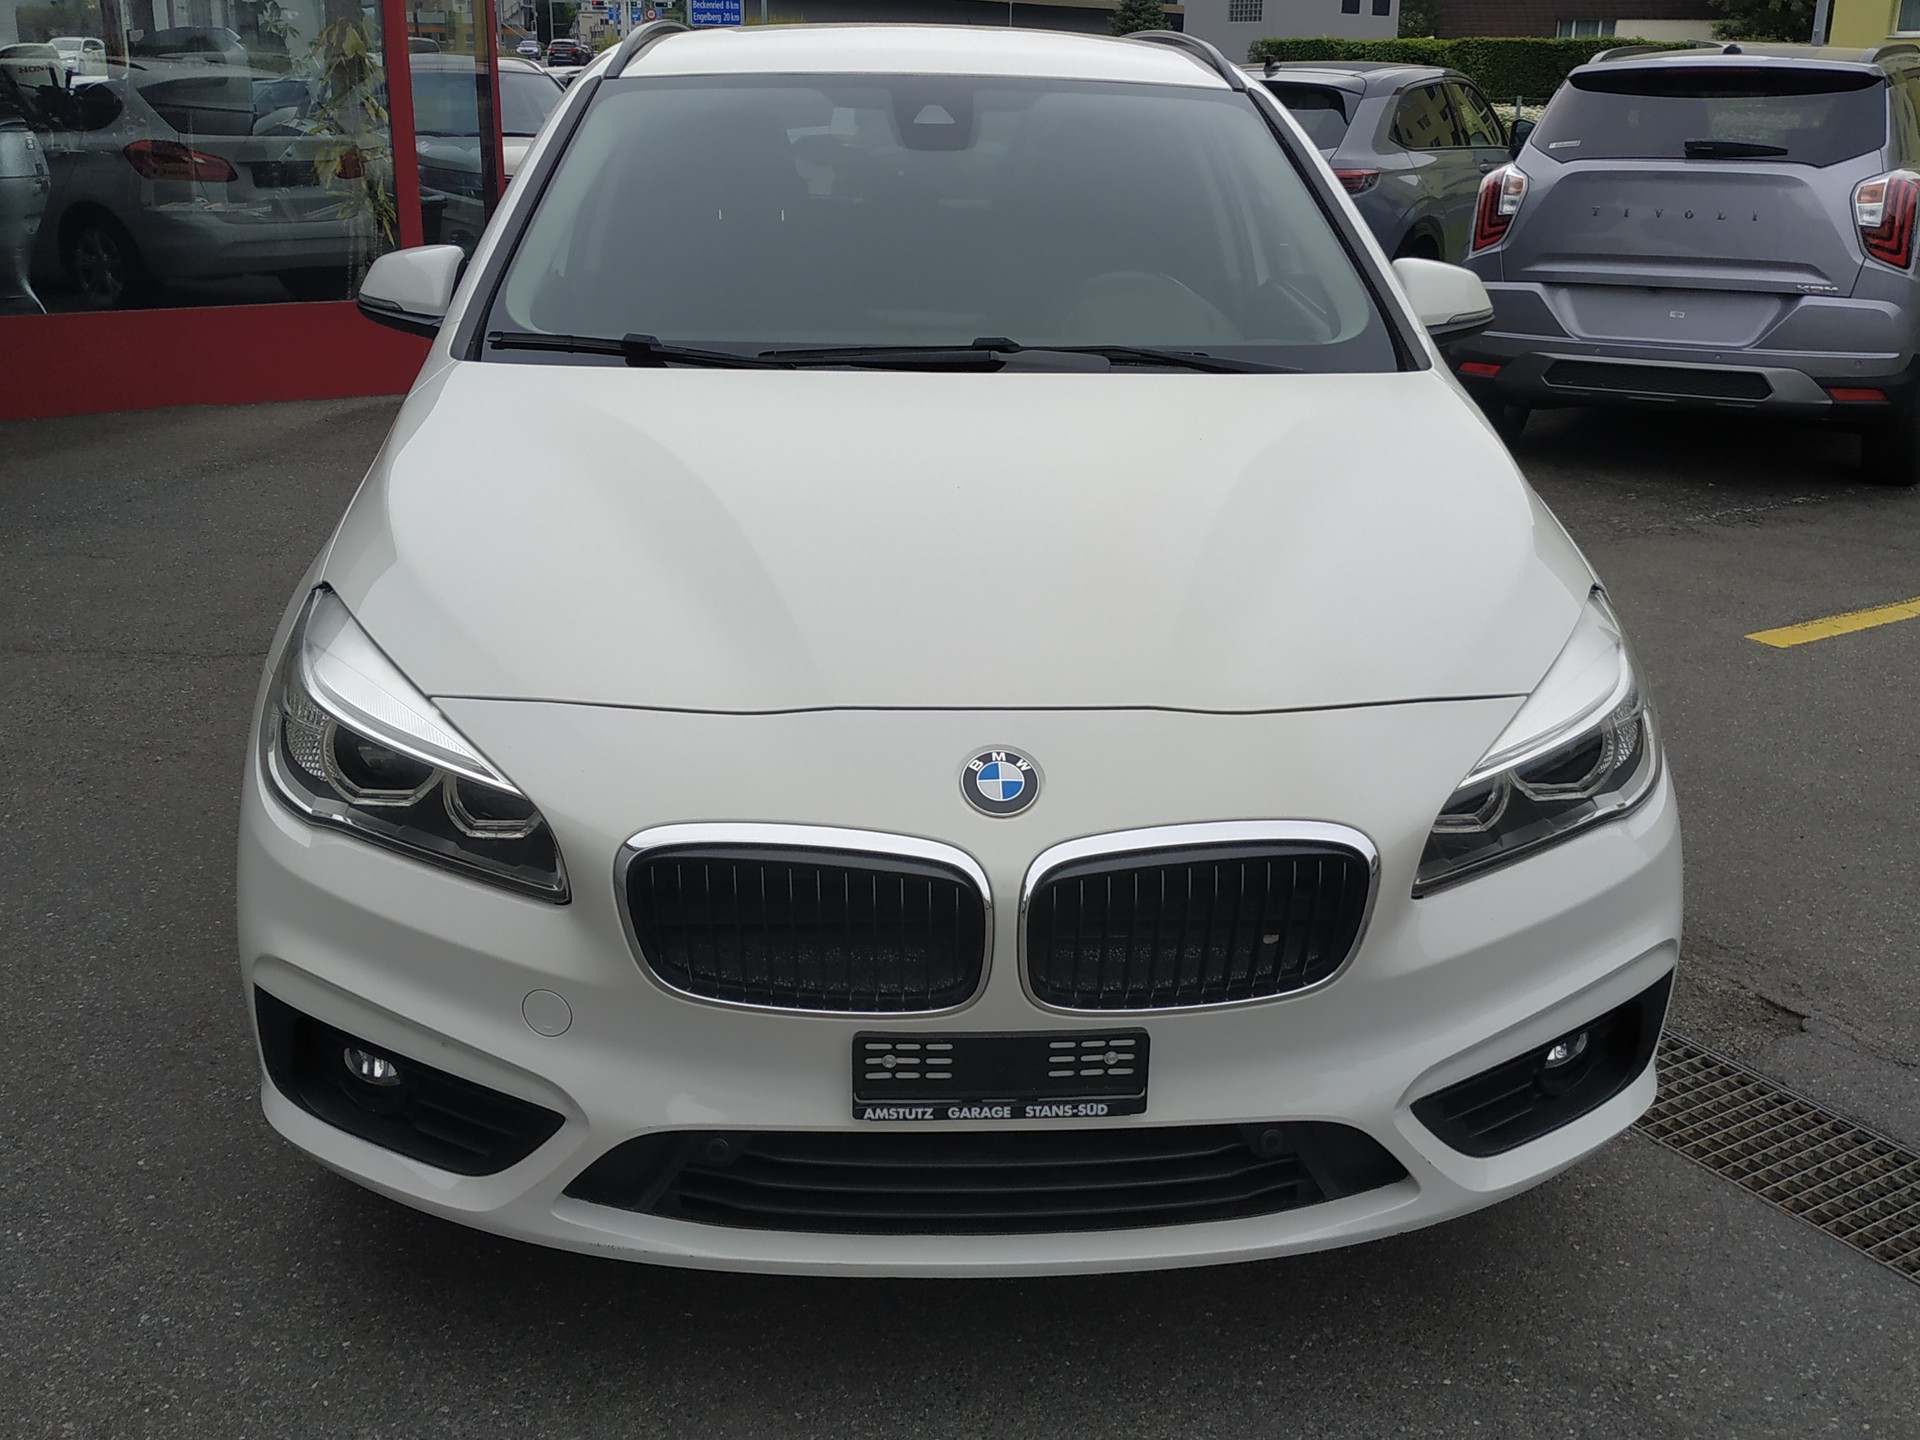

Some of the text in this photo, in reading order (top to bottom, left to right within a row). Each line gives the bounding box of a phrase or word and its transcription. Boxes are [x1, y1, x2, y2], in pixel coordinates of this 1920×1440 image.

[693, 0, 740, 9] Beckenried 8 km
[693, 12, 740, 23] Engelberg 20 km
[1592, 205, 1758, 222] TIVOLI
[968, 752, 1031, 771] BMW
[863, 1103, 1108, 1120] AMSTUTZ GARAGE STANS-SÜD
